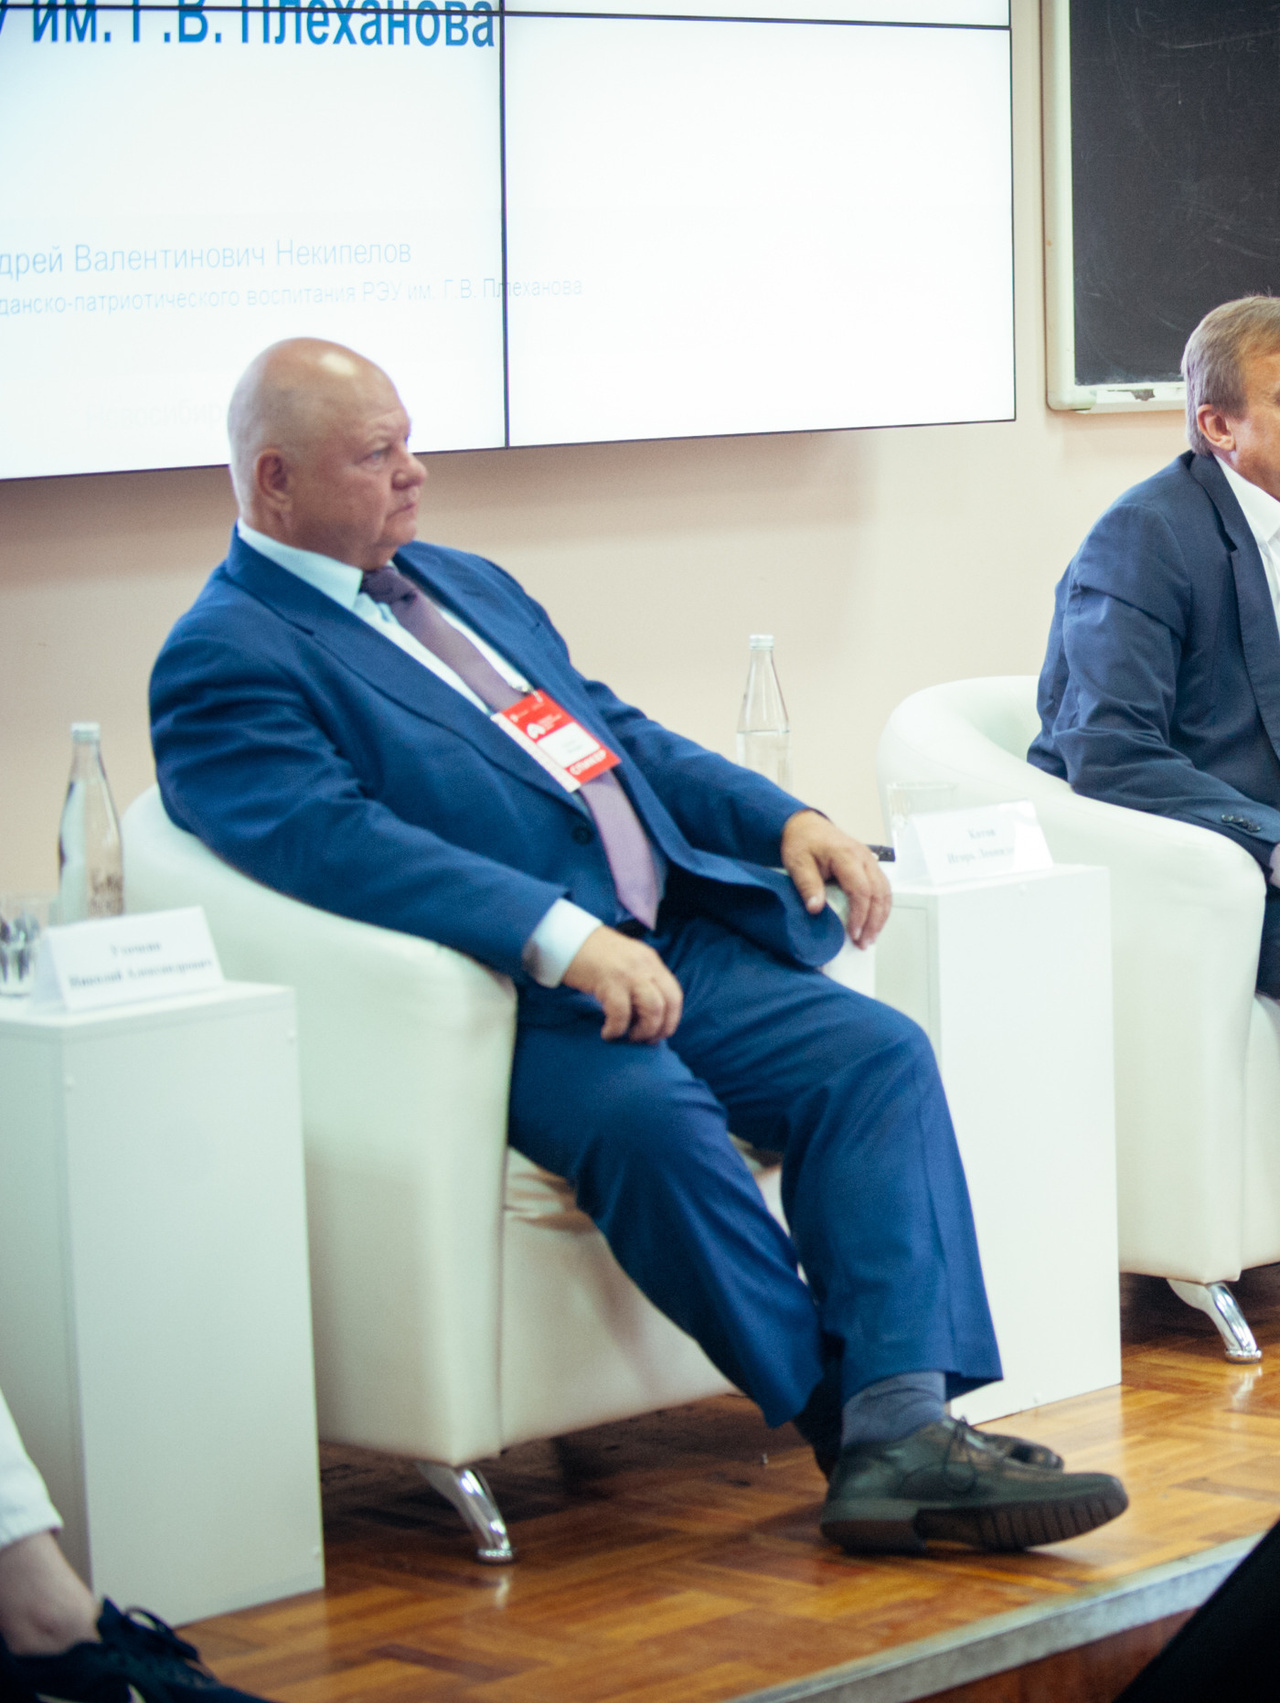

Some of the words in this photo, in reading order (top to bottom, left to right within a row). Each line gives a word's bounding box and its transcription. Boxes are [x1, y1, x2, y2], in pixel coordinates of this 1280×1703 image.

[241, 0, 495, 47] Плеханова
[75, 244, 265, 272] Валентинович
[276, 239, 411, 266] Некипелов
[247, 286, 356, 306] воспитания
[362, 280, 401, 301] РЭУ
